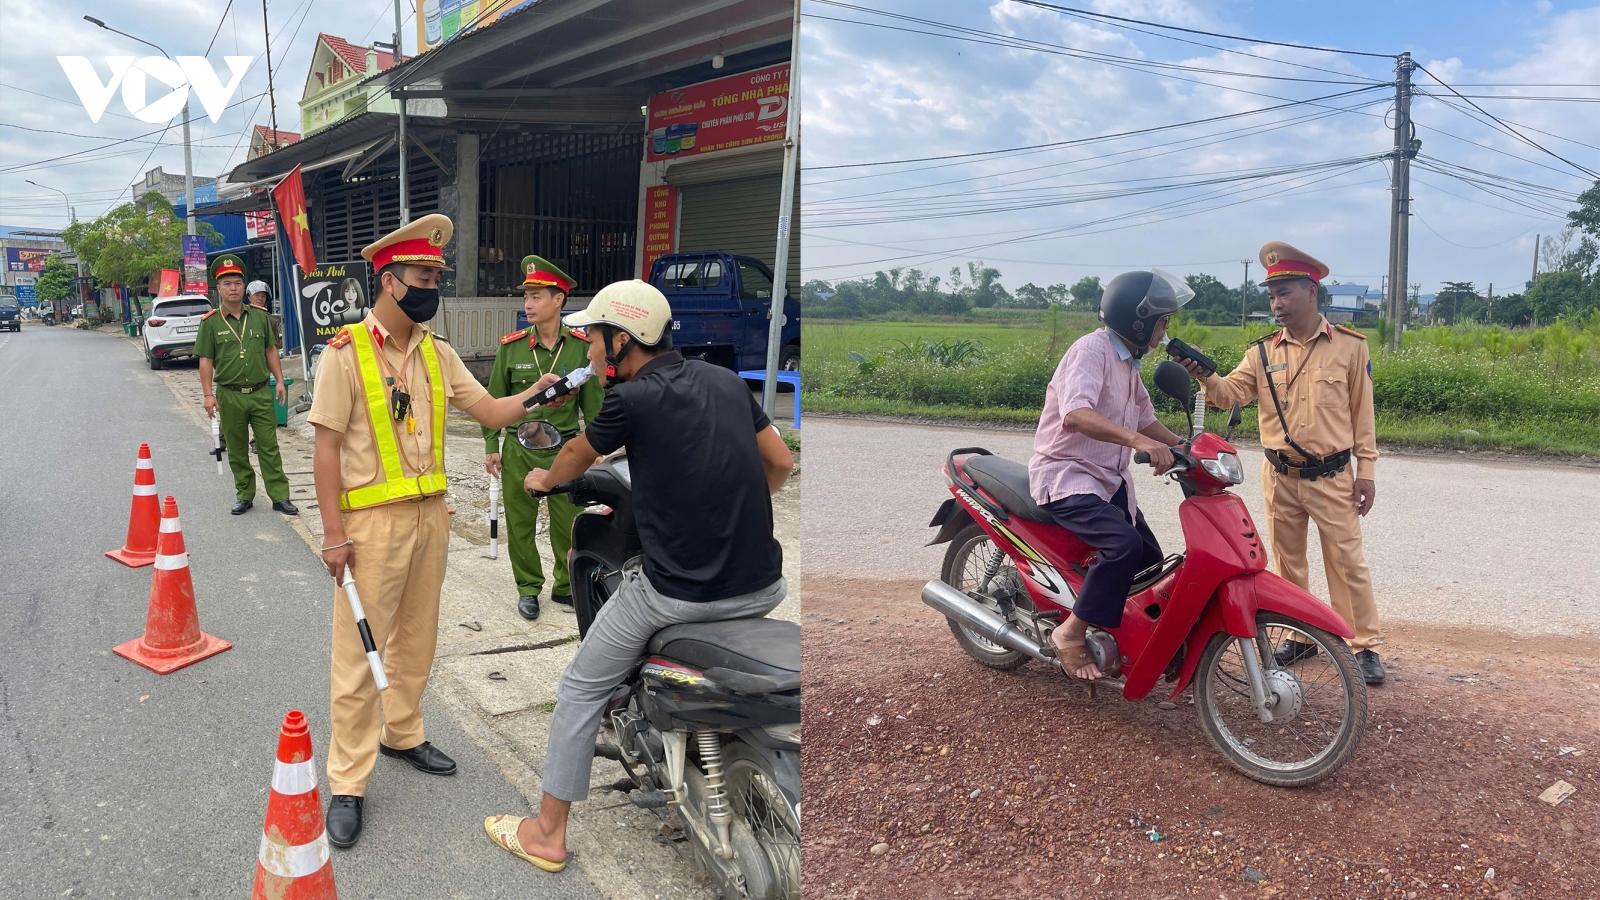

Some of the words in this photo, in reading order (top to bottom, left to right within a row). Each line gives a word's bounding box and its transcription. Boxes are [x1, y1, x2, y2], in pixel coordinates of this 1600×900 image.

[750, 73, 771, 85] CÔNG
[772, 71, 783, 80] TY
[784, 69, 790, 77] T
[712, 93, 738, 108] TỔNG
[741, 87, 764, 101] NHÀ
[767, 81, 790, 96] PHÂ
[701, 118, 719, 129] CHUYÊN
[719, 115, 733, 126] PHÂN
[744, 111, 755, 121] SƠN
[725, 139, 740, 148] CÔNG
[653, 188, 670, 198] TỔNG
[654, 200, 667, 208] KHO
[653, 211, 667, 219] SƠN
[649, 222, 670, 230] PHONG
[648, 232, 669, 241] QUỲNH
[646, 243, 670, 252] CHUYÊN
[301, 280, 351, 326] Tóc
[660, 669, 704, 685] RSX
